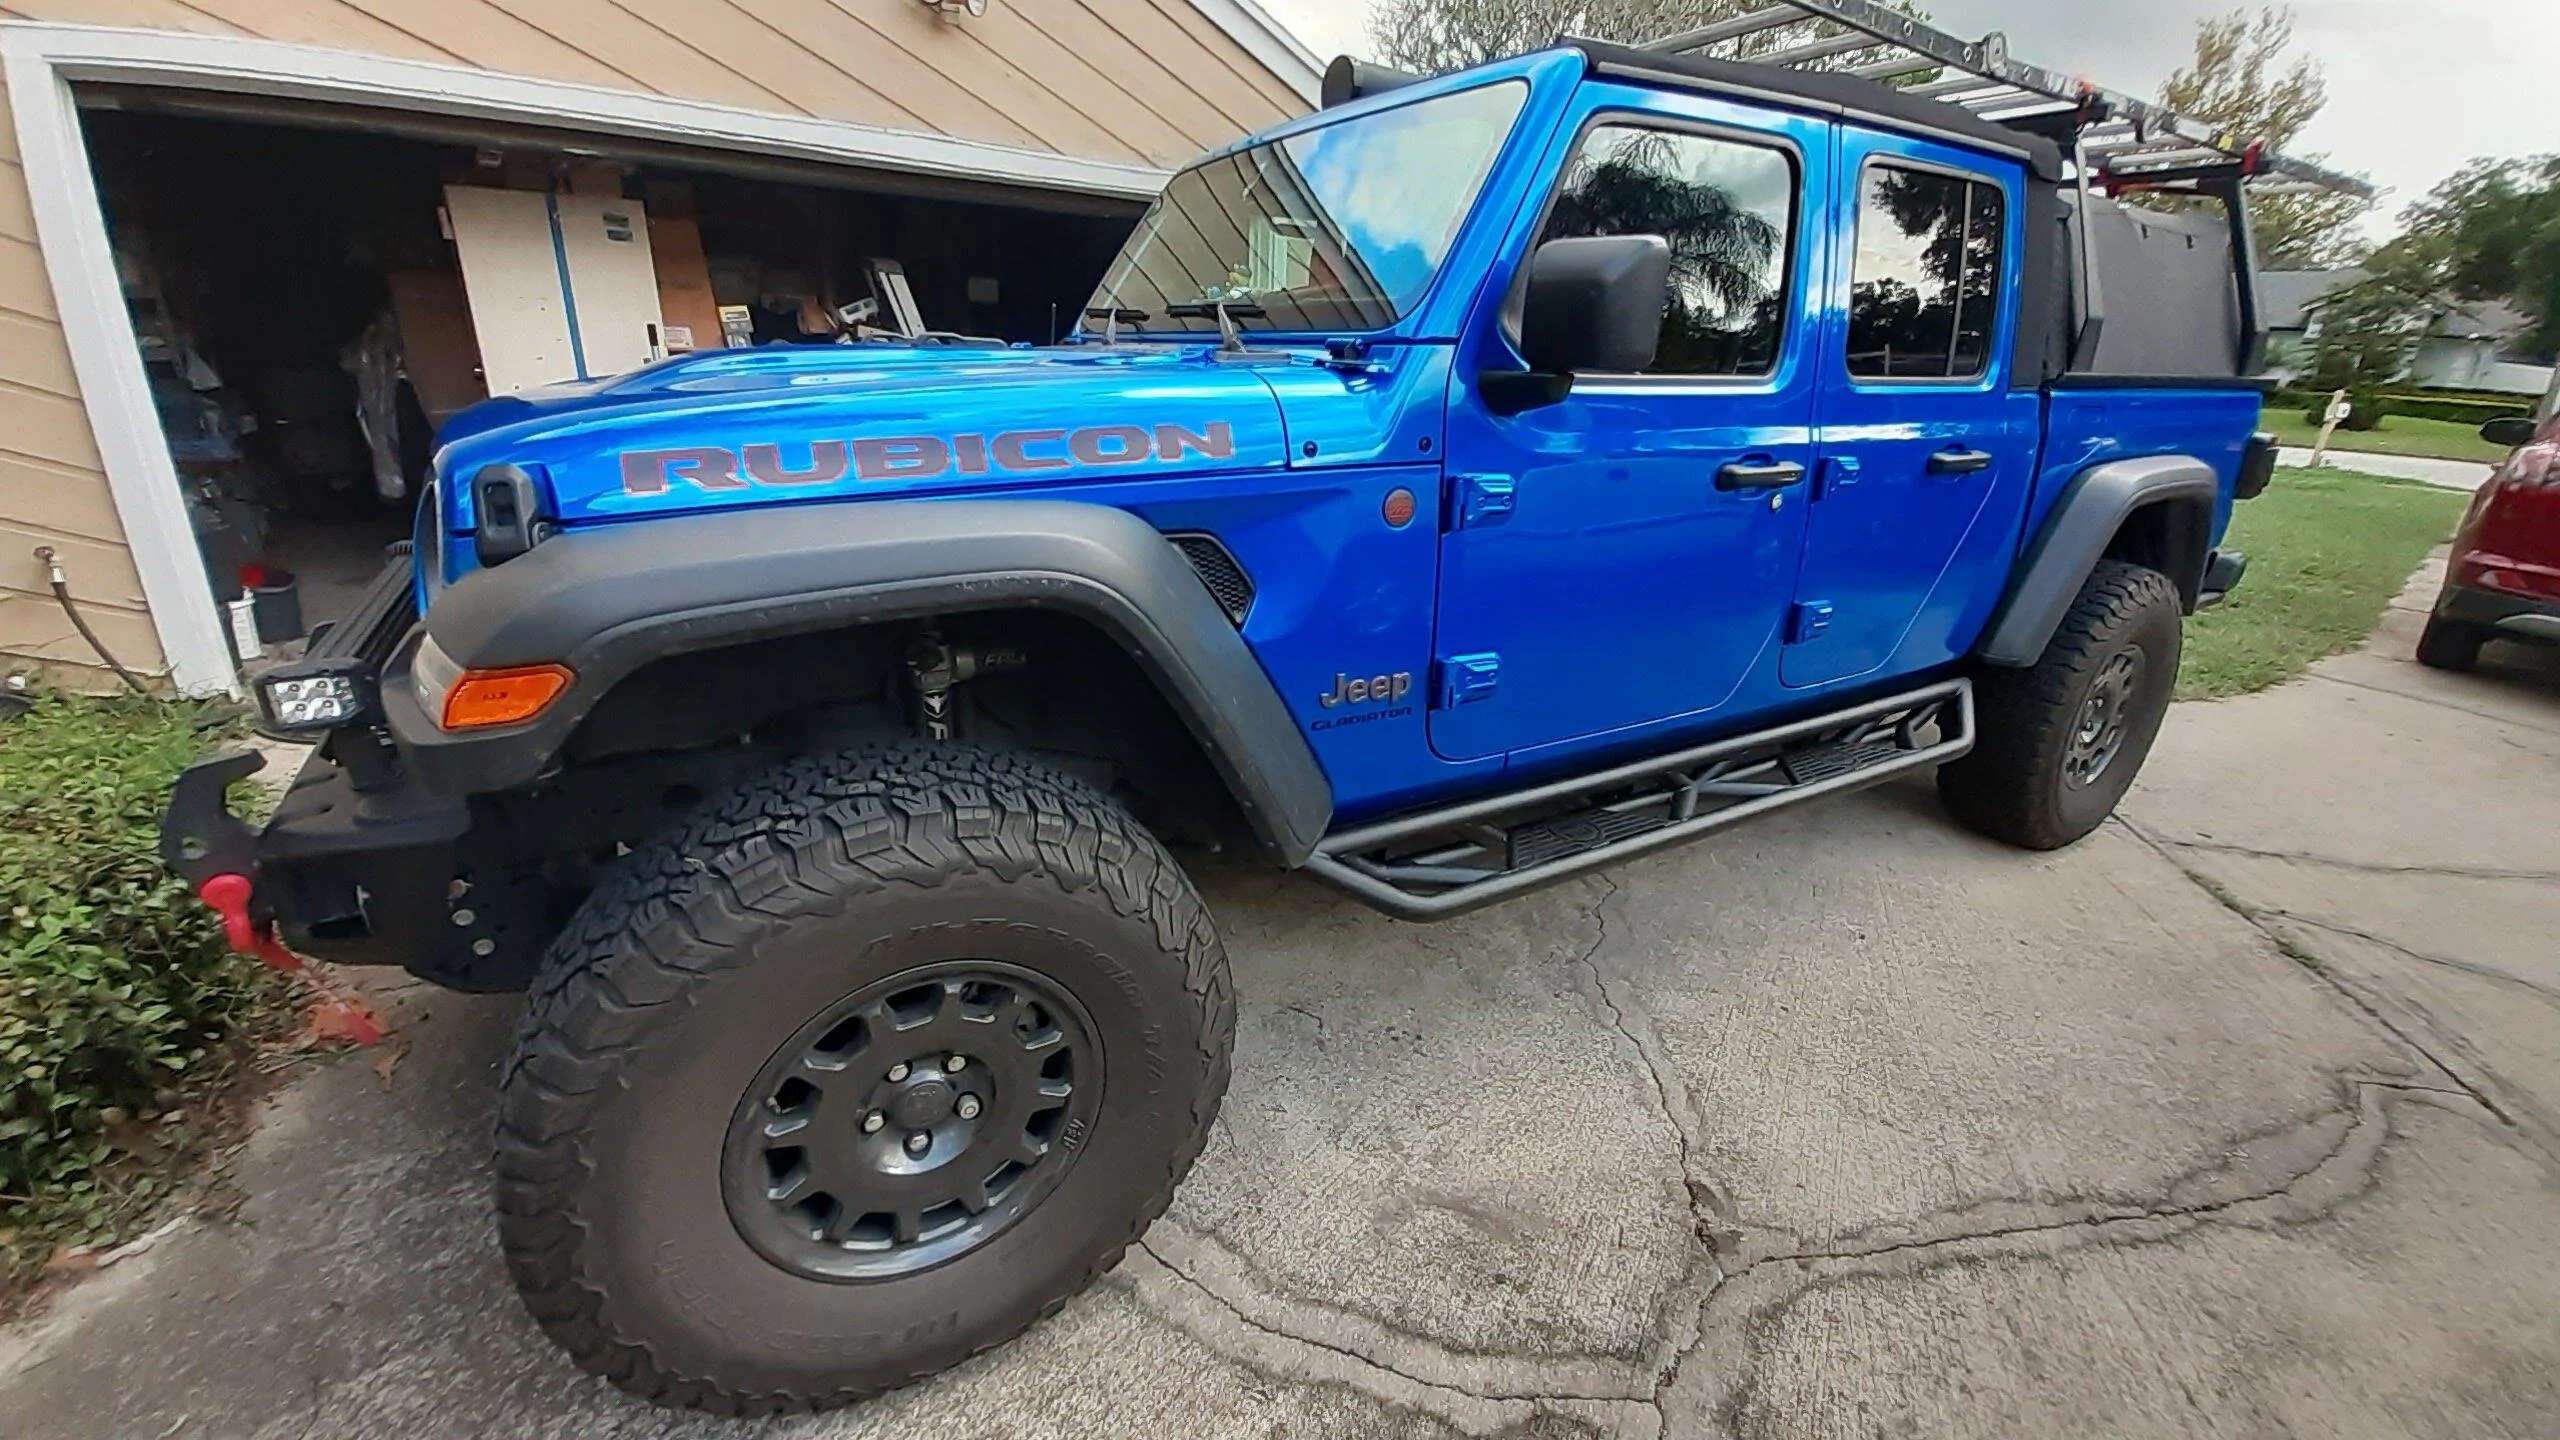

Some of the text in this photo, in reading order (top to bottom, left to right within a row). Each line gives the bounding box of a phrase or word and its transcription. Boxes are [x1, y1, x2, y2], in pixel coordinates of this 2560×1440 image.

[620, 421, 1235, 496] RUBICON
[1320, 671, 1411, 709] Jeep
[1310, 706, 1413, 732] GLADIATOR
